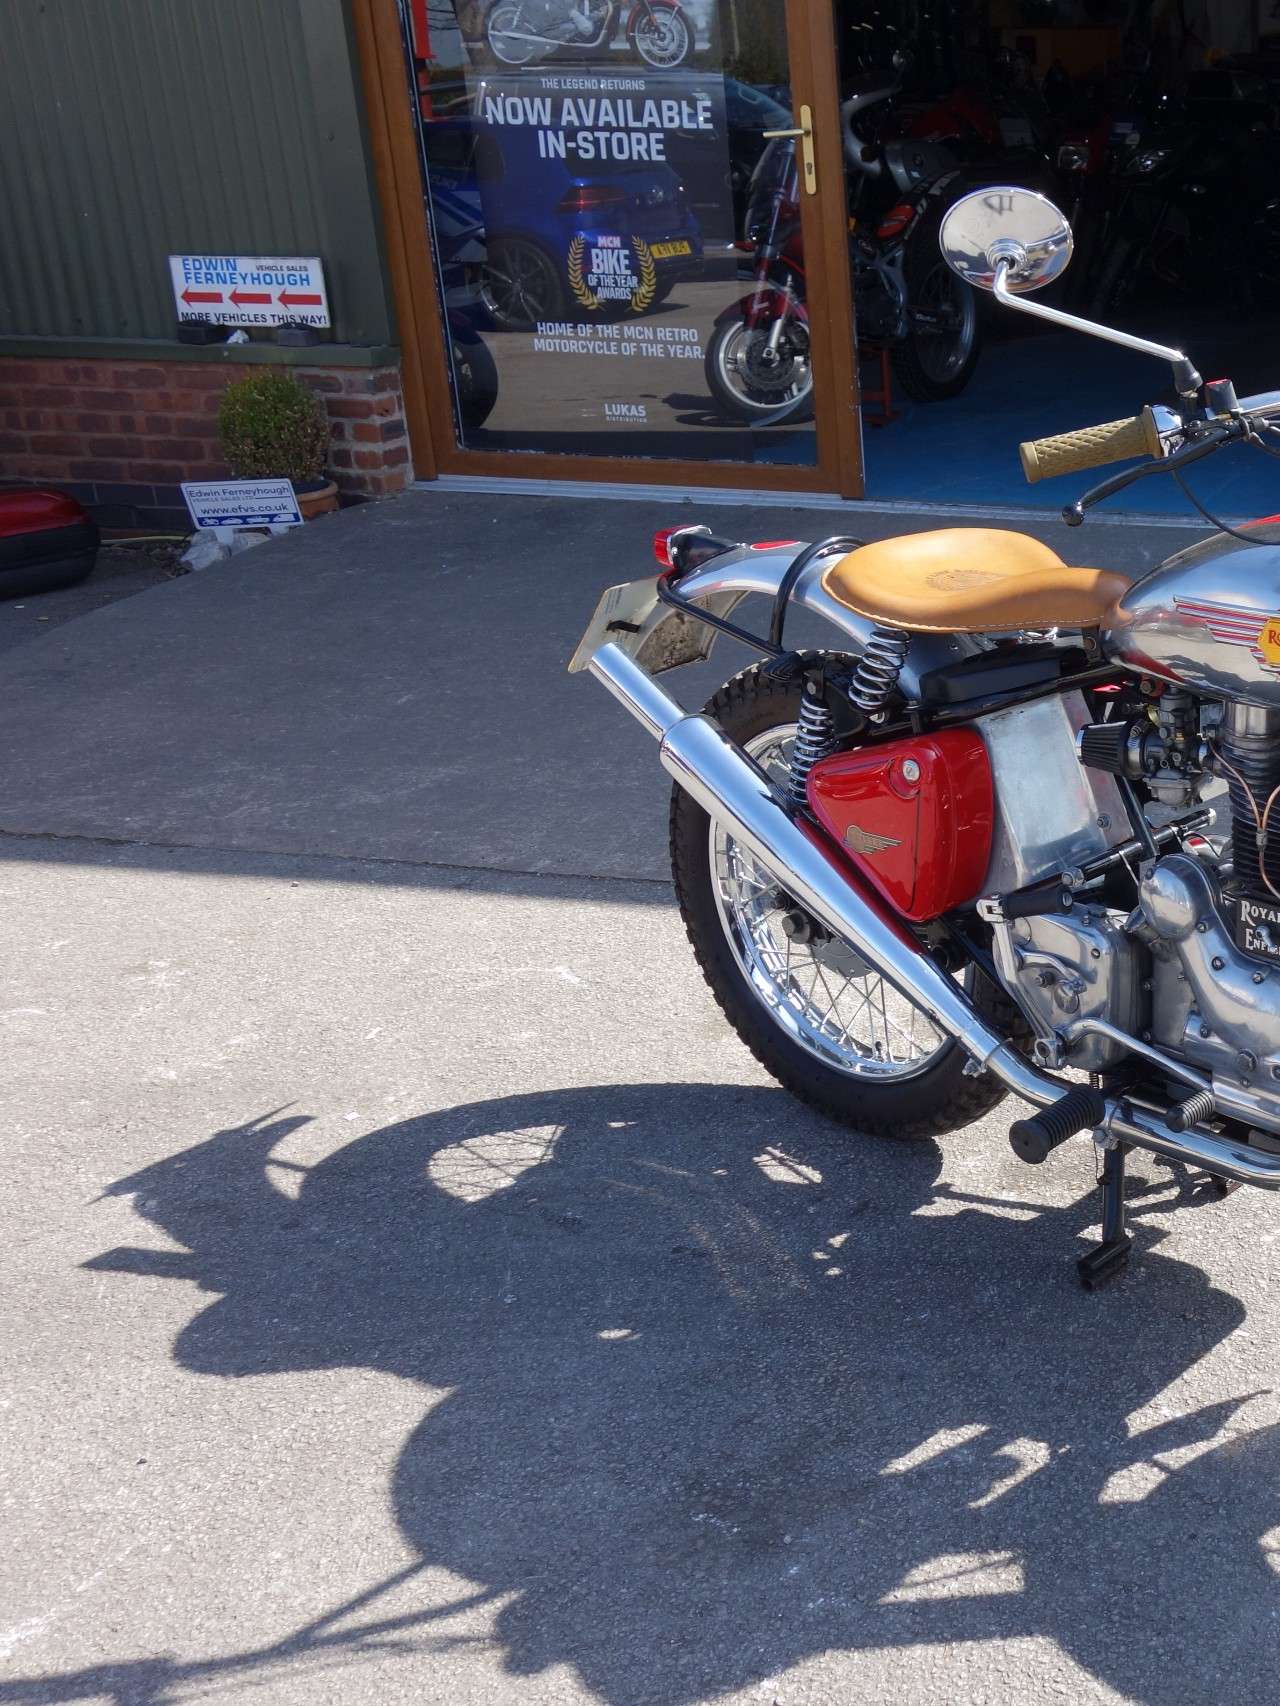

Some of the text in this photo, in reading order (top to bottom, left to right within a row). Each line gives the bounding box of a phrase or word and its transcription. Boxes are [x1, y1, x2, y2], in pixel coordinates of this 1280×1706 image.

[540, 78, 646, 91] THE LEGEND RETURNS
[485, 96, 714, 130] NOW AVAILABLE
[538, 130, 667, 162] IN-STORE
[182, 257, 238, 272] EDWIN
[591, 248, 631, 275] BIKE
[184, 271, 310, 287] FERNEYHOUGH
[588, 274, 639, 288] OF THE YEAR
[597, 287, 632, 300] AWARDS
[181, 312, 328, 325] MORE VEHICLES THIS WAY!
[536, 322, 698, 342] HOME OF THE MCN RETRO
[534, 338, 706, 359] MOTORCYCLE OF THE YEAR.
[604, 403, 646, 417] LUKAS
[189, 489, 220, 498] Edwin
[221, 486, 290, 497] Ferneyhough
[200, 503, 289, 515] www.efvs.co.uk
